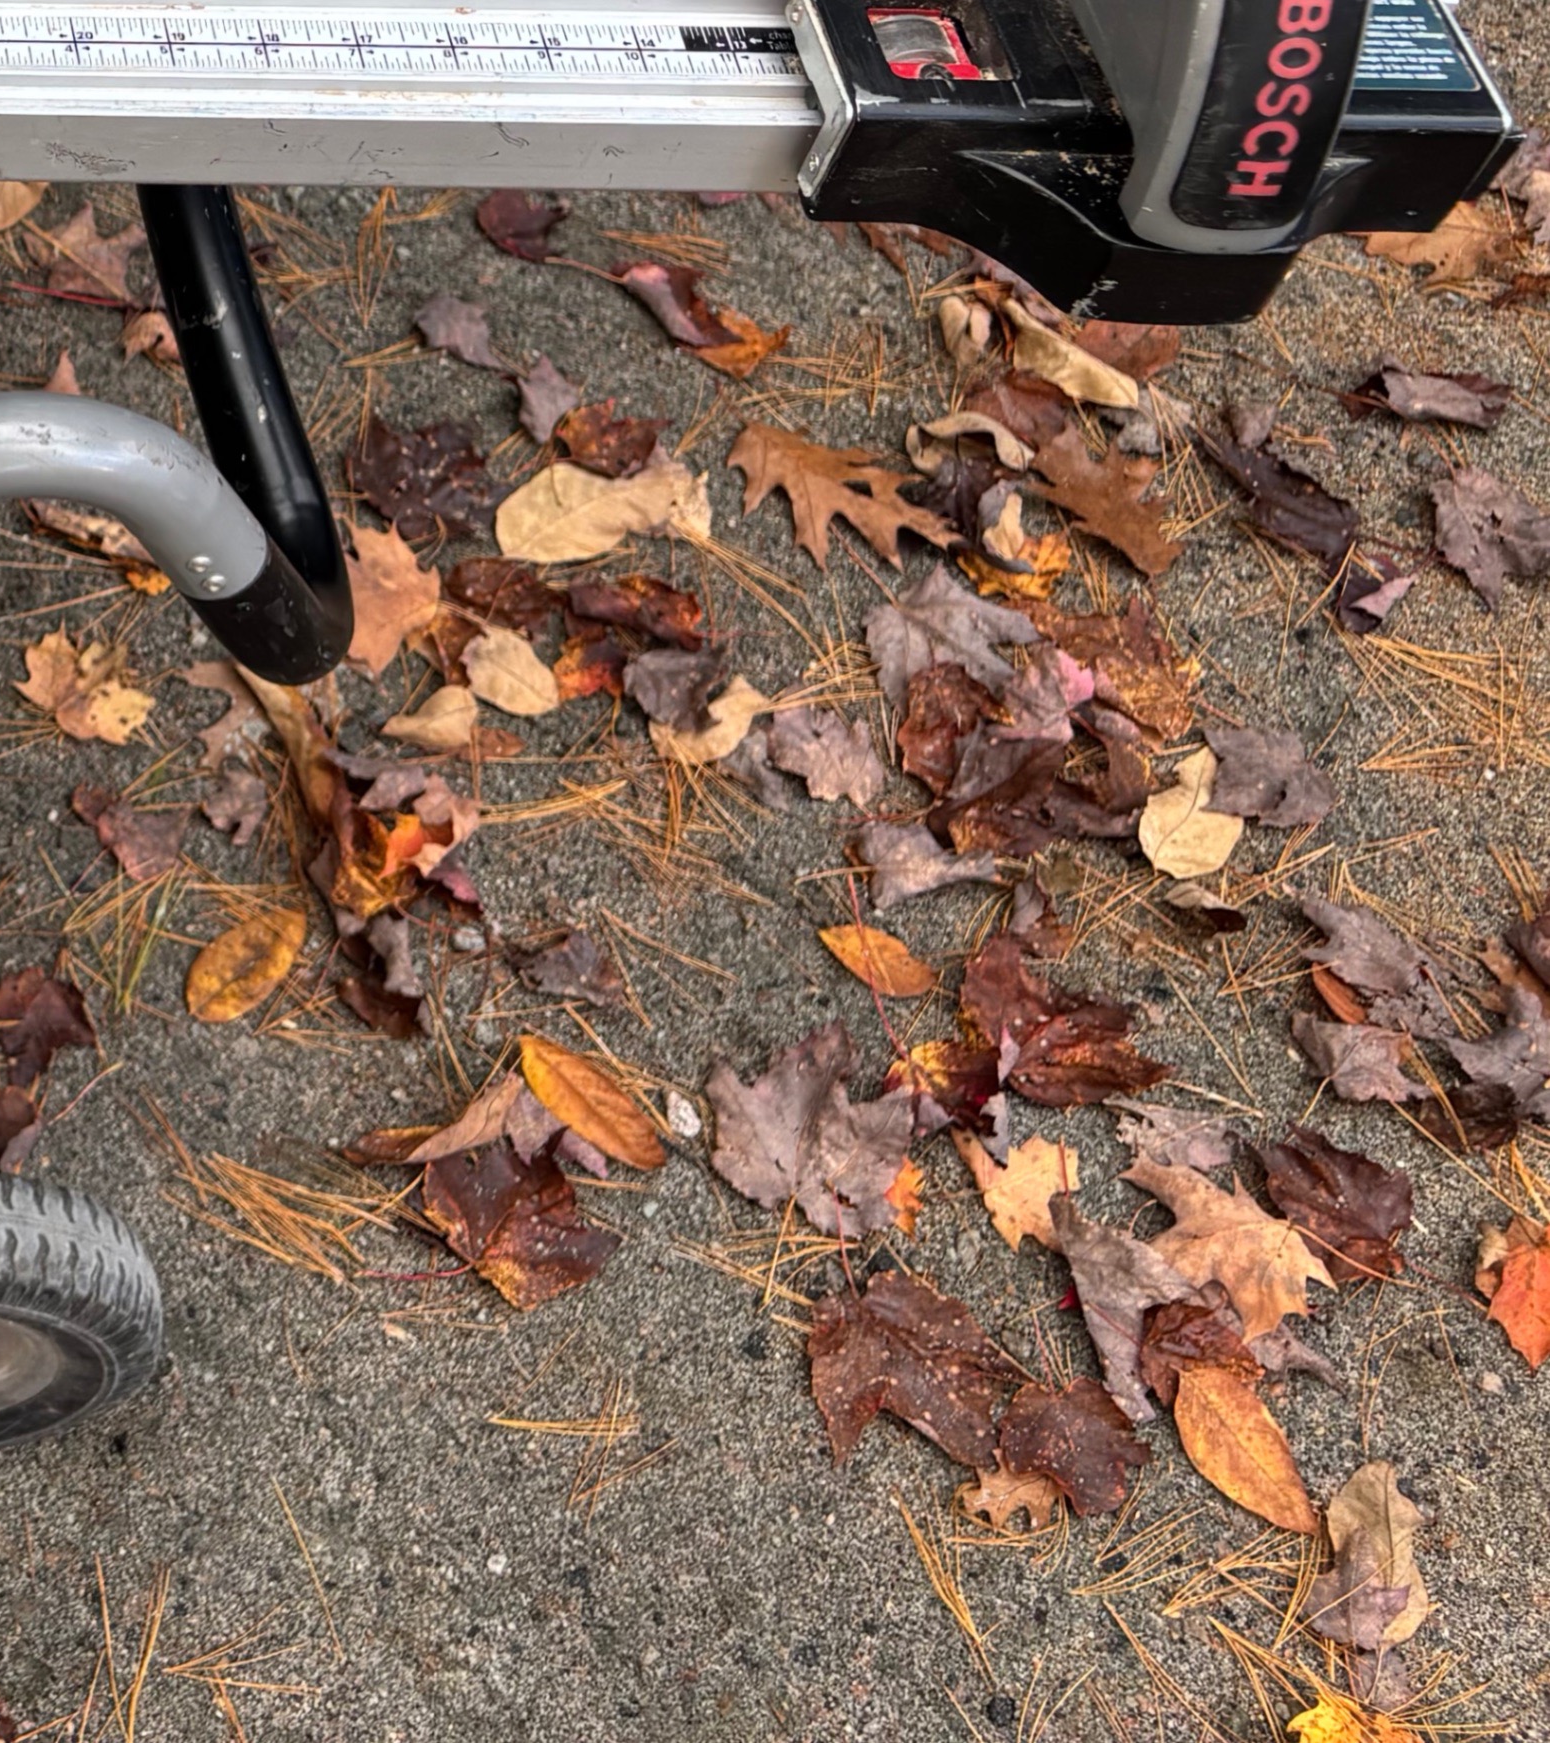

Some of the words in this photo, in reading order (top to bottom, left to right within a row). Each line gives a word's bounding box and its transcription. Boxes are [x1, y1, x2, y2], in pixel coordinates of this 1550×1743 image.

[77, 31, 94, 40] 20
[171, 32, 186, 41] 19
[265, 33, 280, 42] 18
[360, 35, 373, 43] 17
[453, 36, 468, 45] 16
[547, 38, 561, 46] 15
[641, 39, 656, 48] 14
[65, 44, 74, 53] 4
[160, 46, 169, 54] 5
[254, 47, 263, 56] 6
[349, 48, 356, 57] 7
[537, 50, 546, 60] 9
[624, 52, 640, 61] 10
